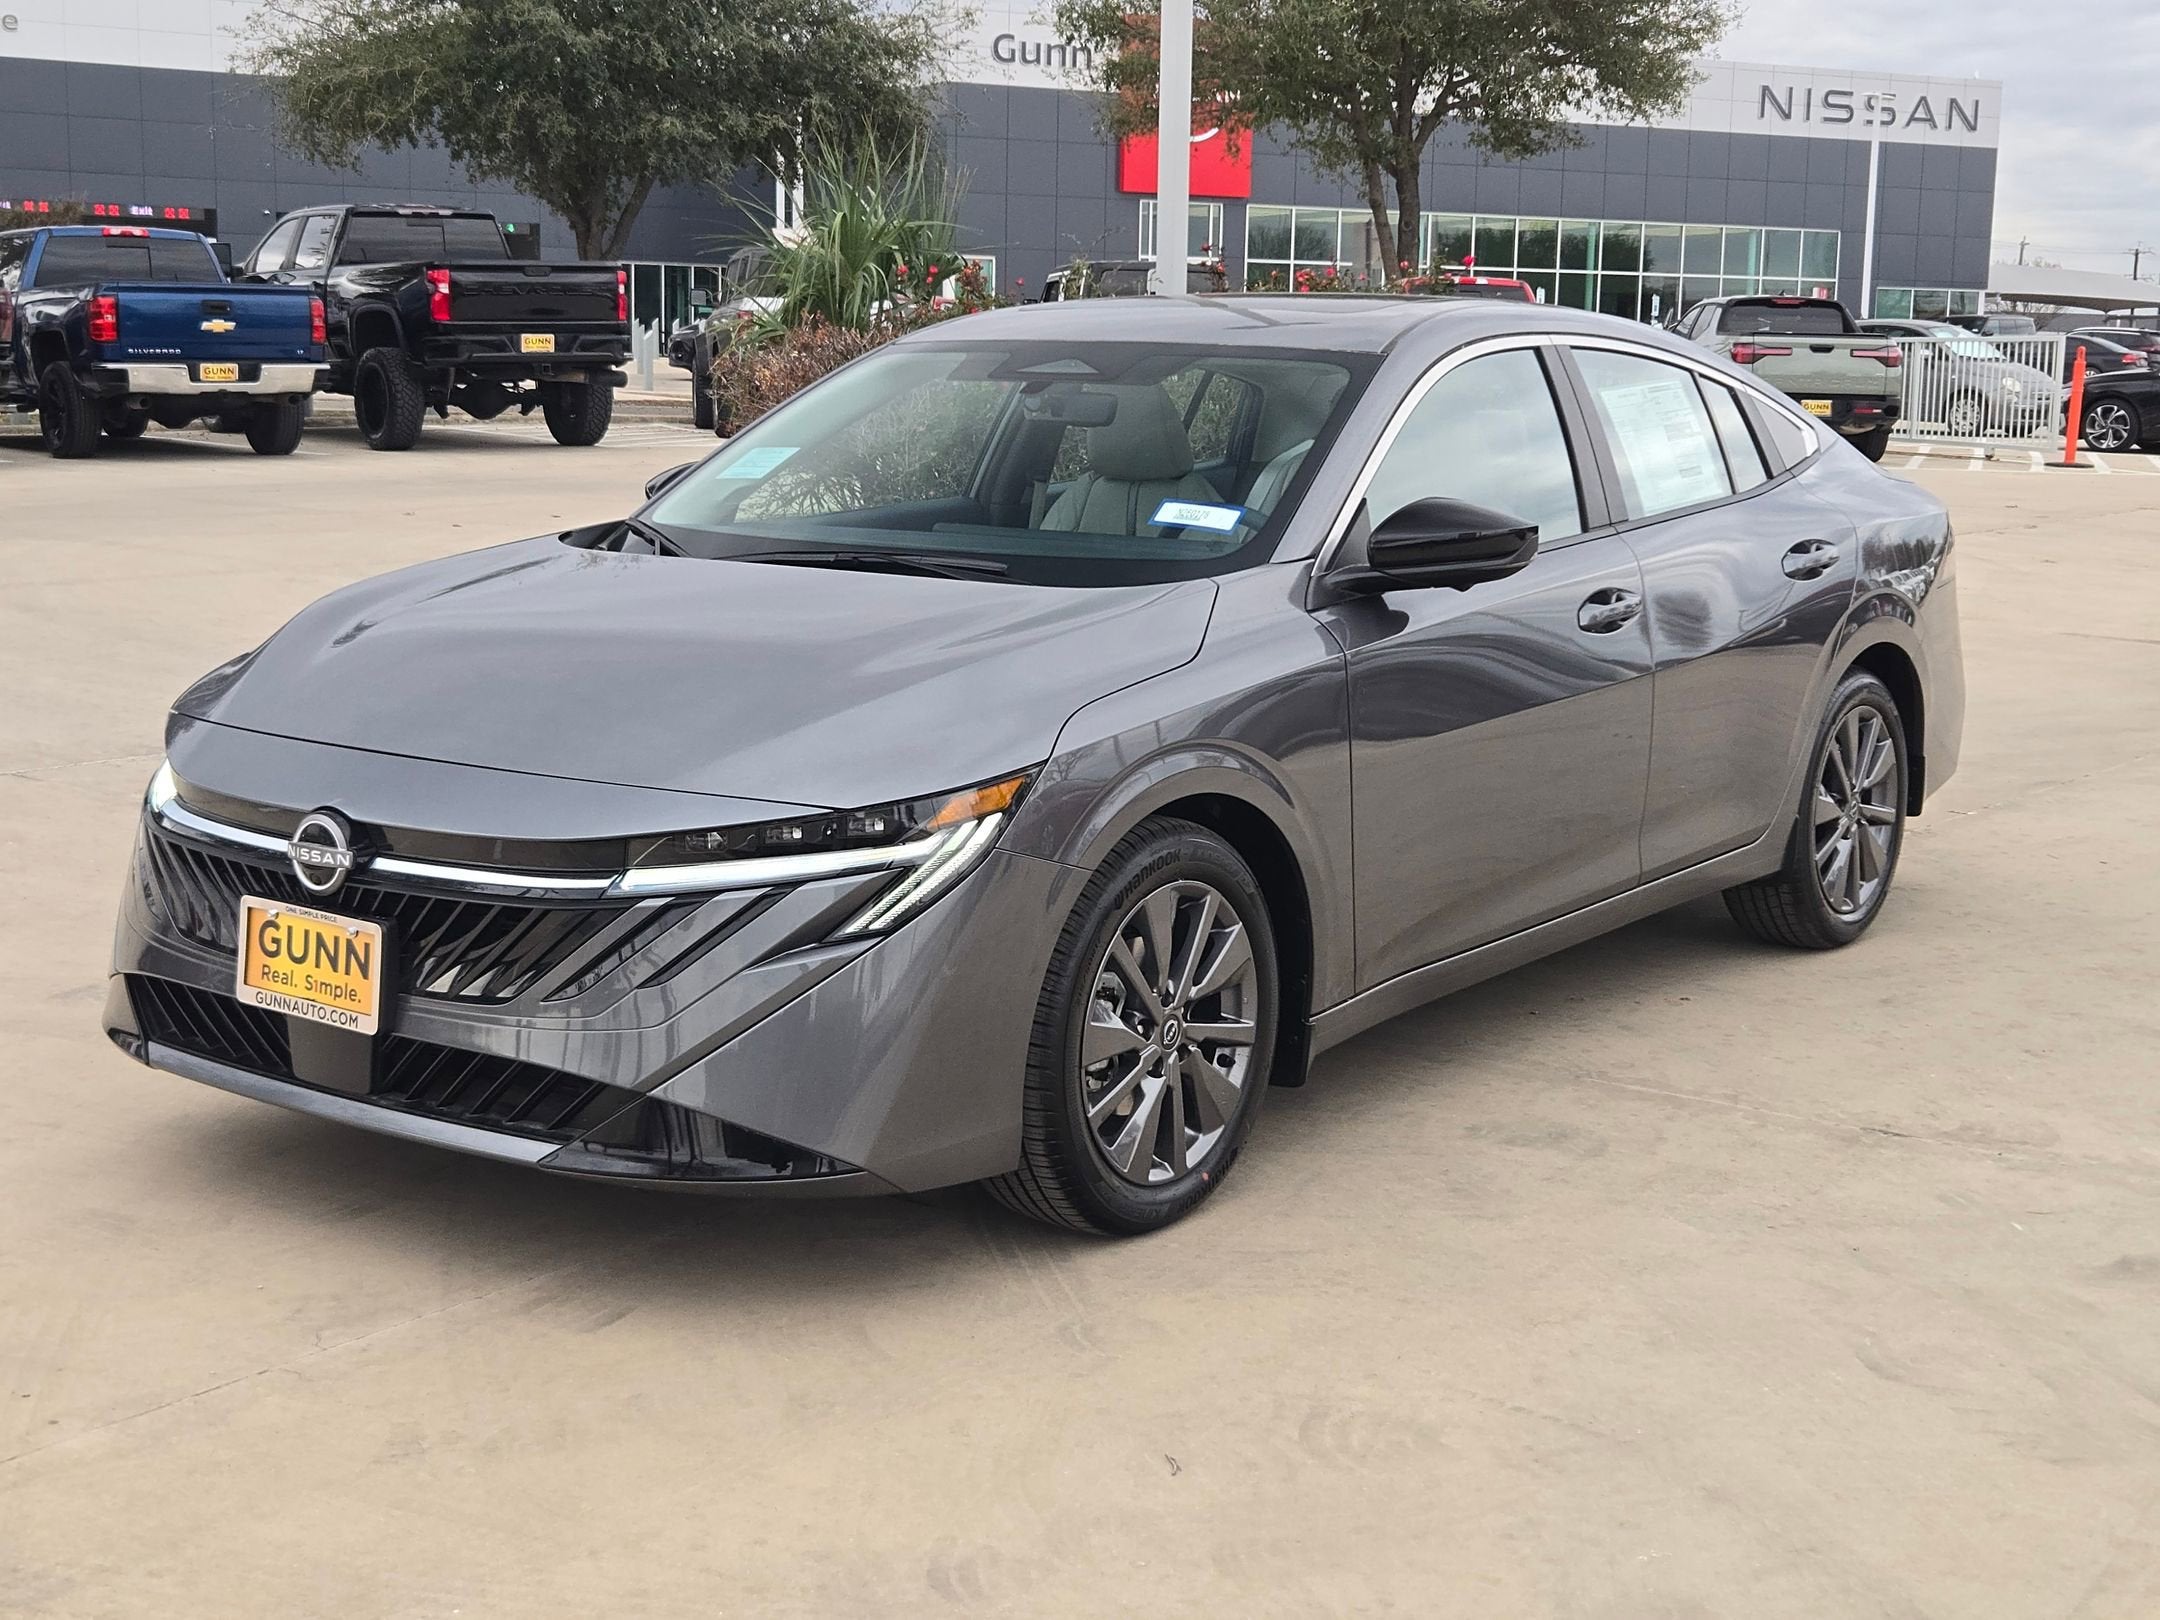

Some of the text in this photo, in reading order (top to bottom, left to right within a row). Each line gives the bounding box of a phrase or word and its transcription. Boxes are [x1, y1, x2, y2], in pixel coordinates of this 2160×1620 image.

[992, 33, 1092, 71] Gunn
[1758, 84, 1980, 132] NISSAN
[524, 337, 551, 345] GUNN
[204, 367, 234, 375] GUNN
[1803, 402, 1829, 410] GUNN
[288, 843, 350, 866] NISSAN
[286, 905, 338, 923] ONE SIMPLE PRICE
[258, 919, 371, 980] GUNN
[261, 964, 297, 988] Real.
[255, 991, 359, 1029] GUNNAUTO.COM
